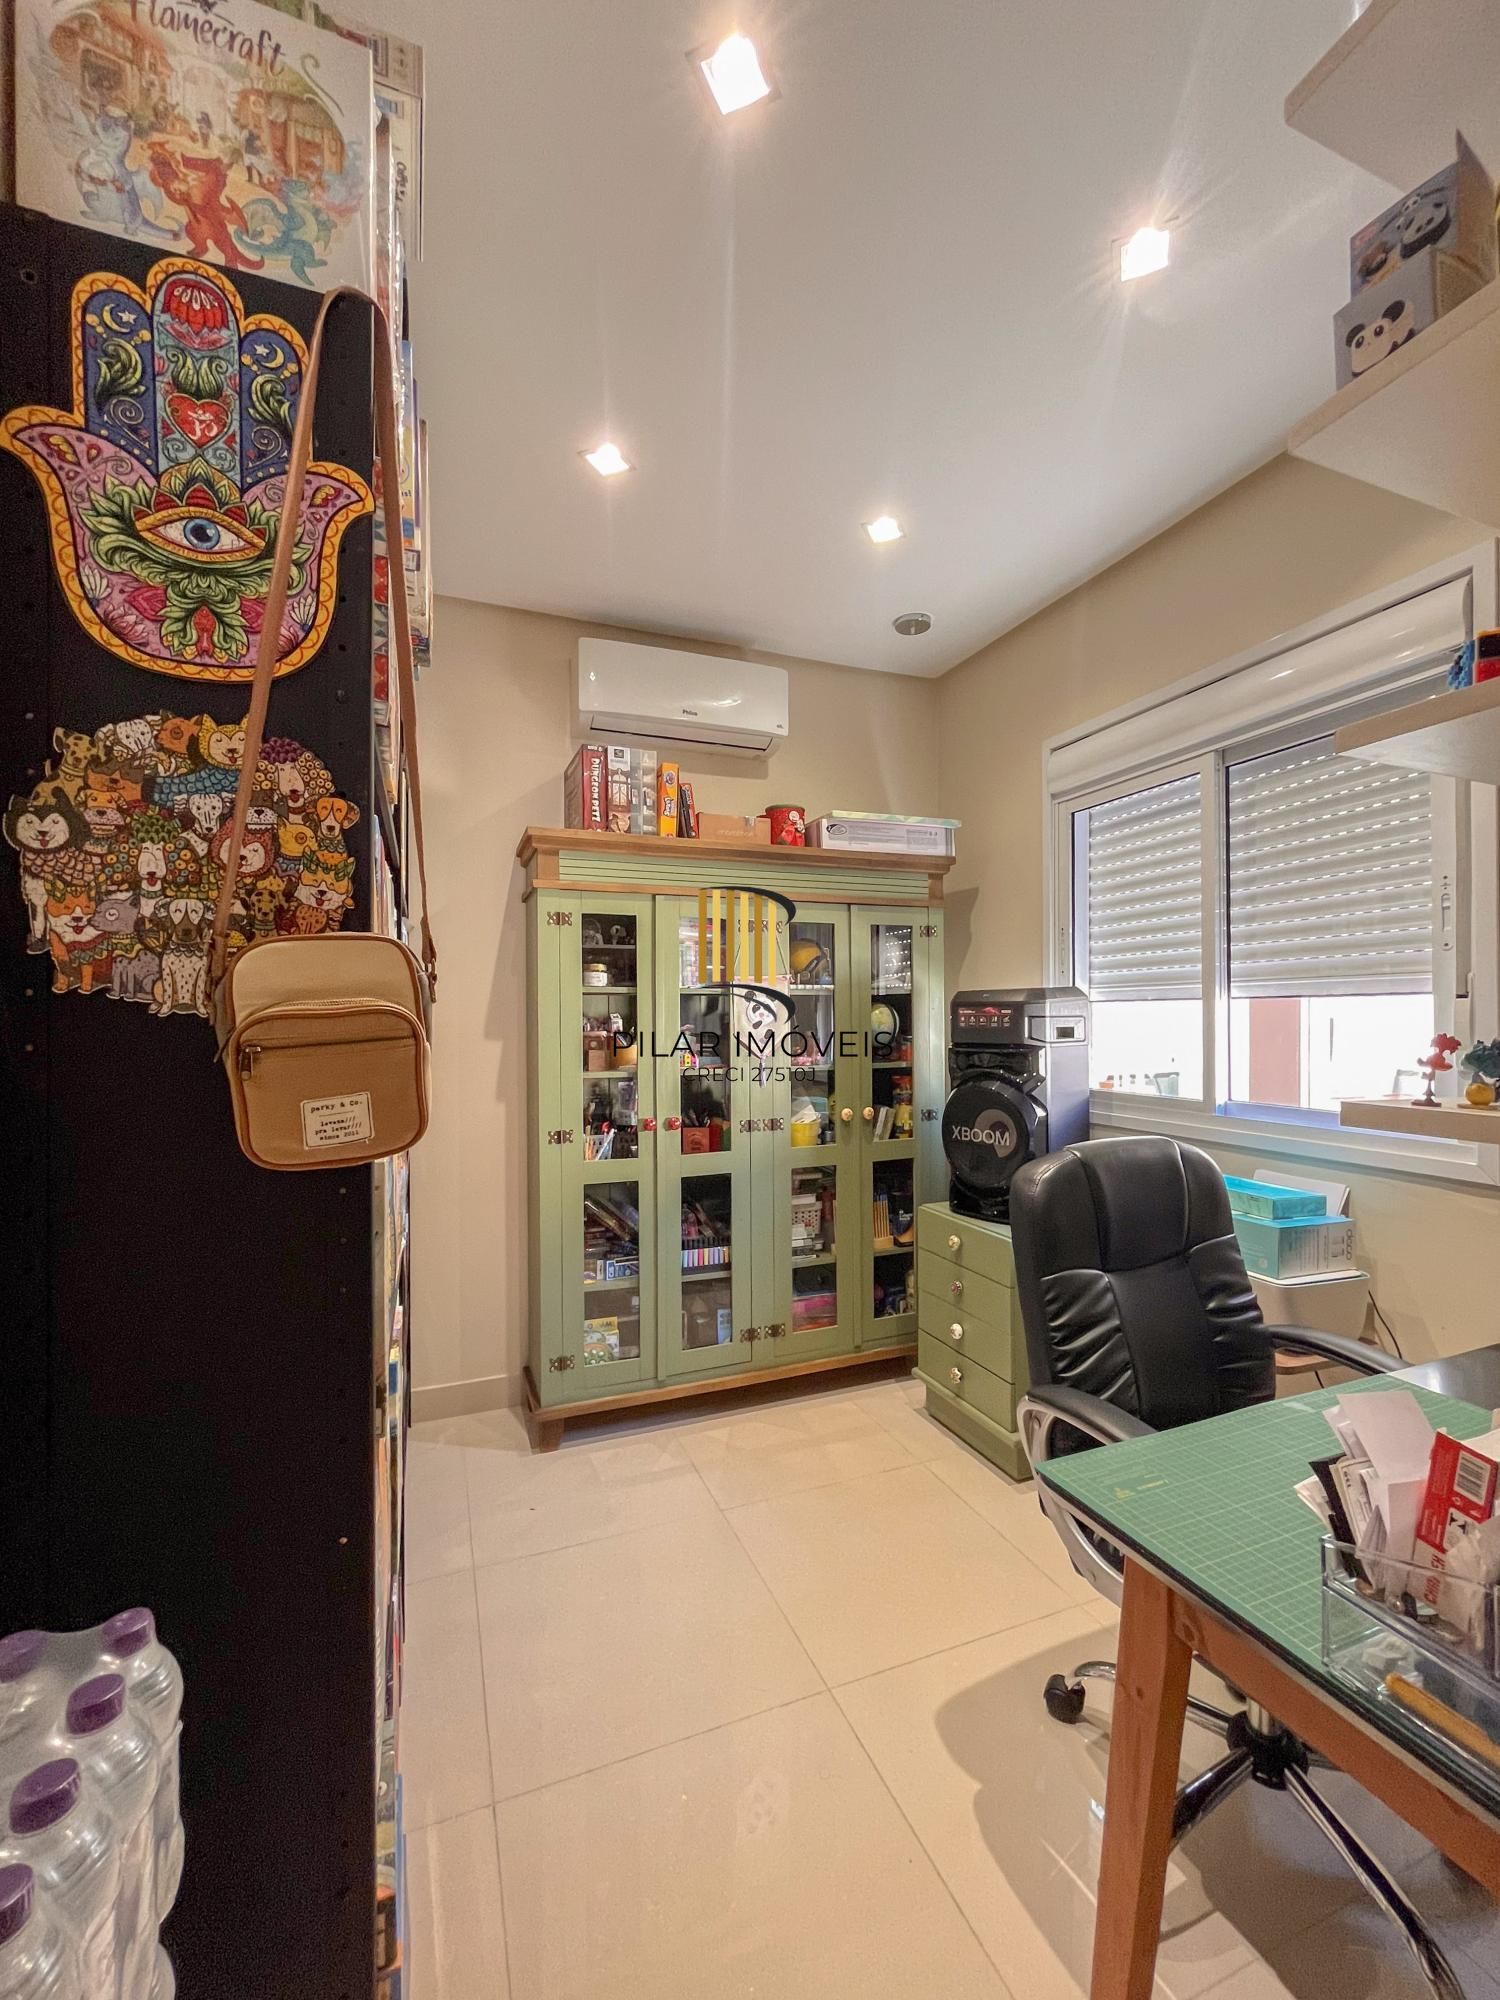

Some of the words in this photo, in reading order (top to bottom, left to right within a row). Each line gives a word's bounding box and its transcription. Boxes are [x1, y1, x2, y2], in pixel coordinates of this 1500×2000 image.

[591, 757, 602, 797] DUNGEON
[591, 798, 602, 823] PETZ
[952, 1126, 1010, 1146] XBOOM
